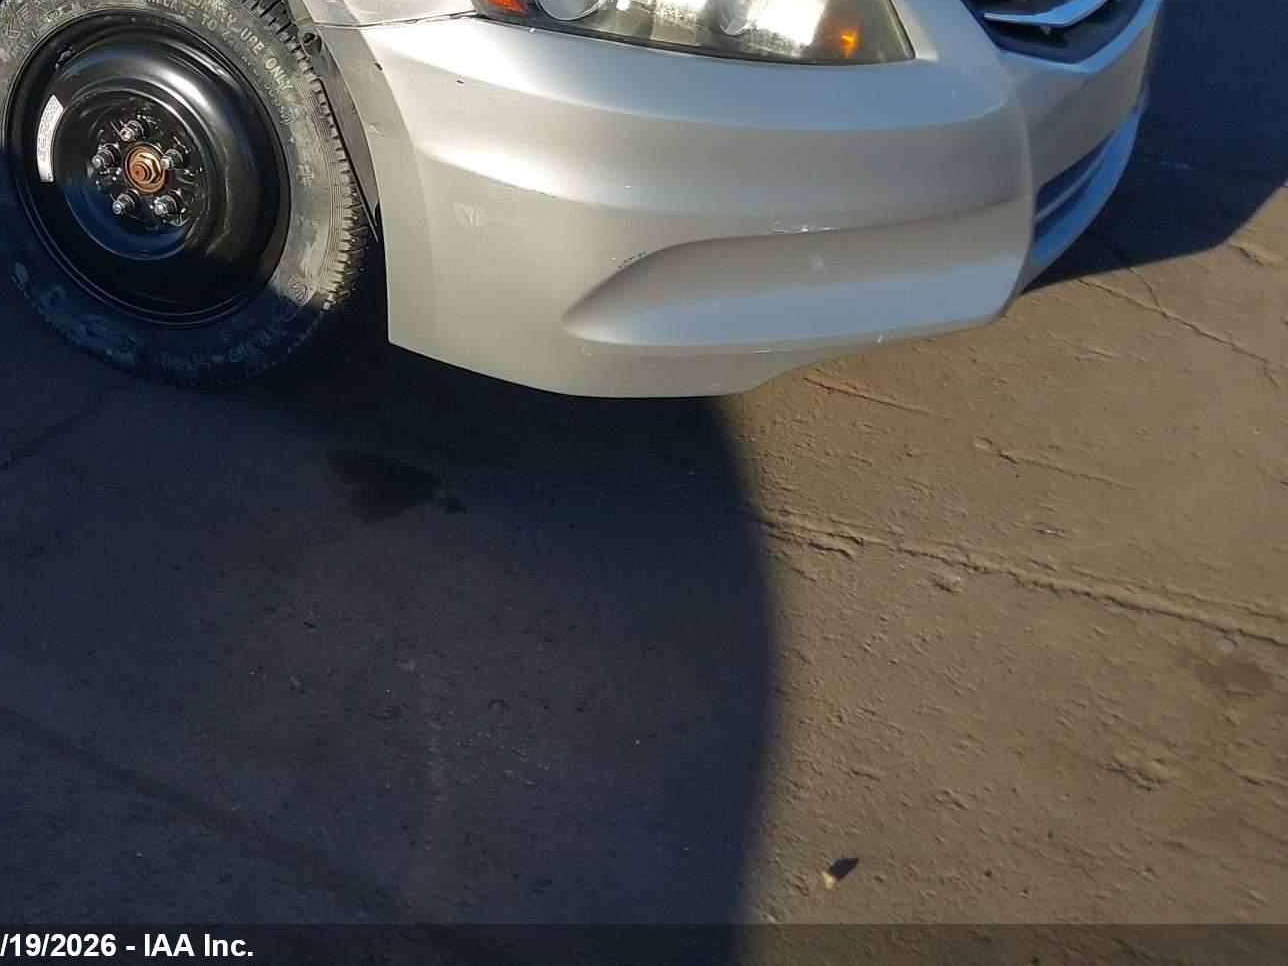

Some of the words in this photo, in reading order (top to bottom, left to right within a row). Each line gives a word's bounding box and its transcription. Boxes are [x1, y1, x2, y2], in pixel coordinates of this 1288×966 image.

[201, 14, 218, 31] TO
[240, 27, 265, 55] USE
[265, 57, 293, 90] ONLY
